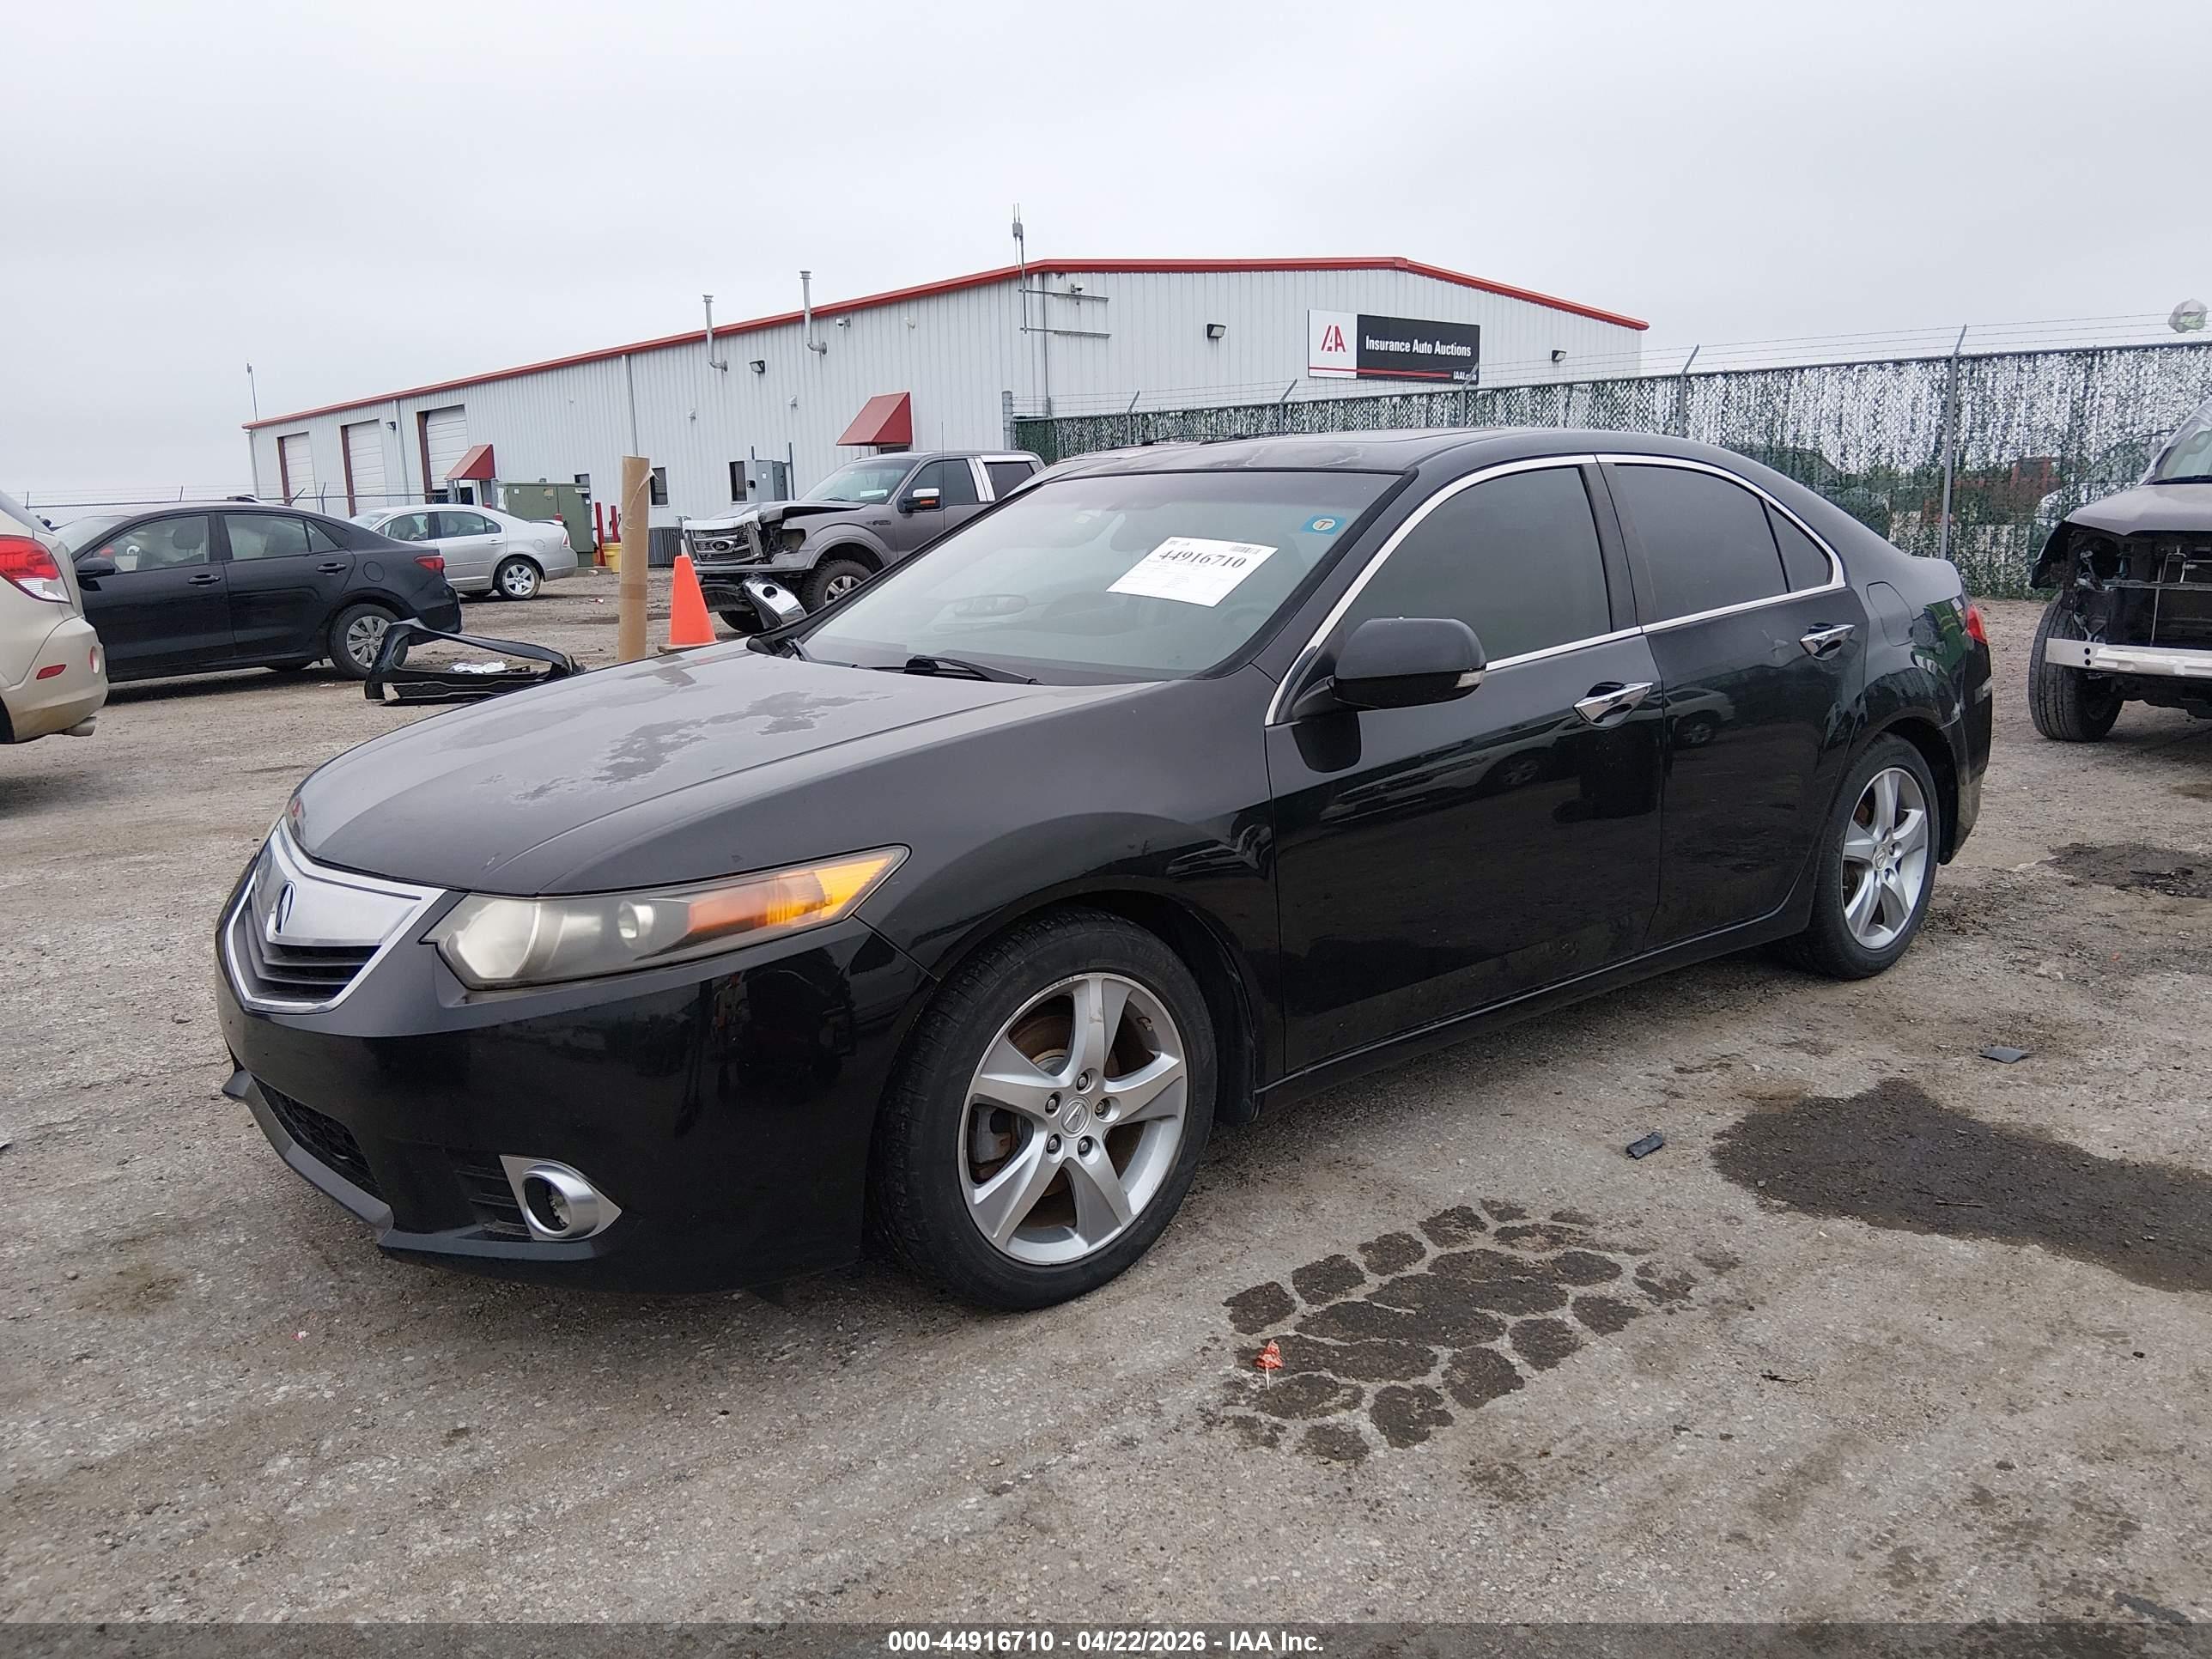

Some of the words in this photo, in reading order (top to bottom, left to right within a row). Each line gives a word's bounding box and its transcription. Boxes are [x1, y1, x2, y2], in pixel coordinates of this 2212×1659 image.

[1365, 335, 1411, 352] Insurance
[1412, 338, 1432, 354] Auto
[1434, 340, 1471, 356] Auctions
[1159, 550, 1247, 568] 44916710
